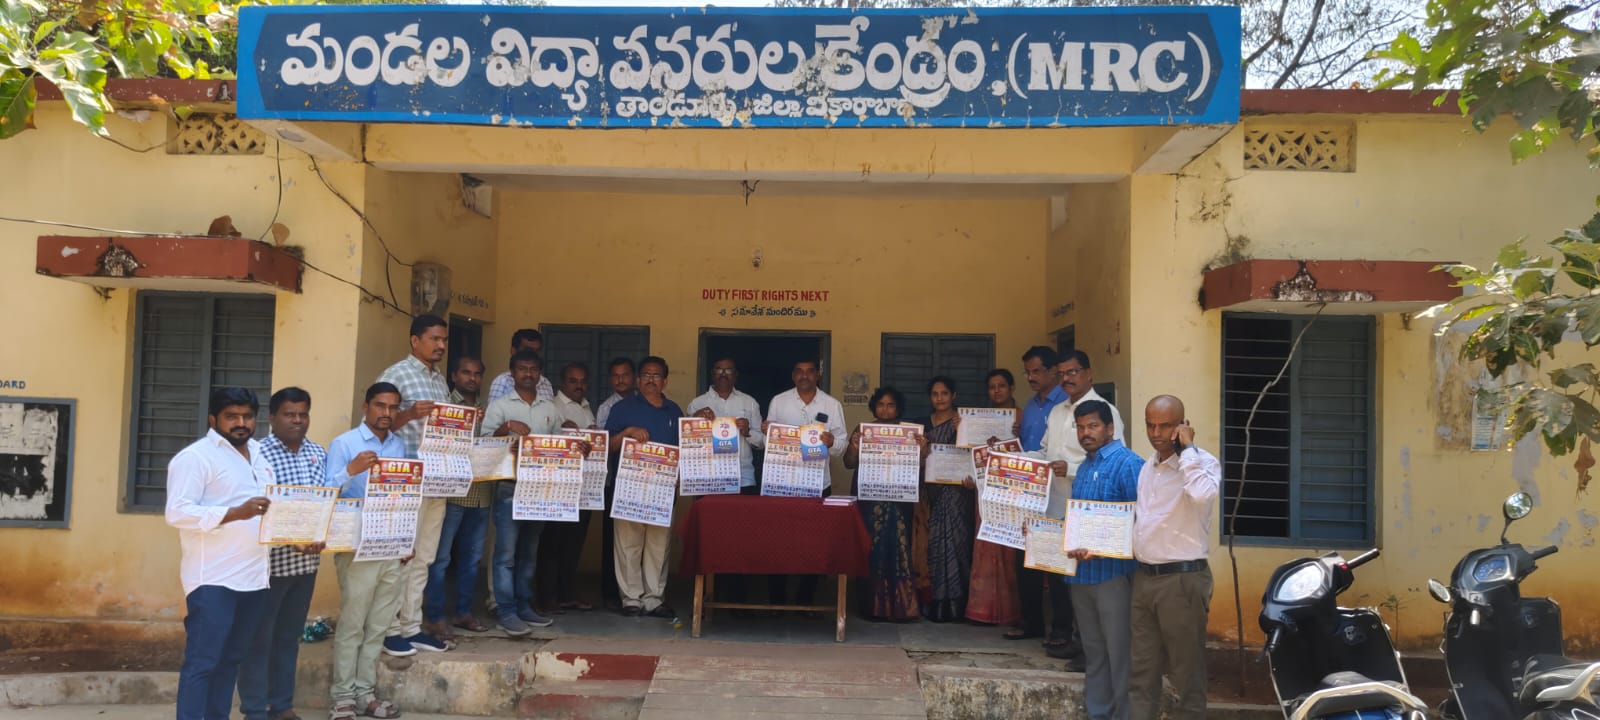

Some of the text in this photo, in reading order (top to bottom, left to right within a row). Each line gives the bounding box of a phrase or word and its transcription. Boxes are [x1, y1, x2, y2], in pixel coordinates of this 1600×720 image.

[280, 22, 472, 87] మండల
[484, 26, 599, 111] విద్యా
[1007, 31, 1211, 101] (MRC)
[702, 288, 829, 302] DUTY FIRST RIGHTS NEXT
[880, 427, 904, 437] GTA
[541, 437, 567, 449] GTA
[388, 461, 411, 473] GTA
[1007, 458, 1033, 472] GTA
